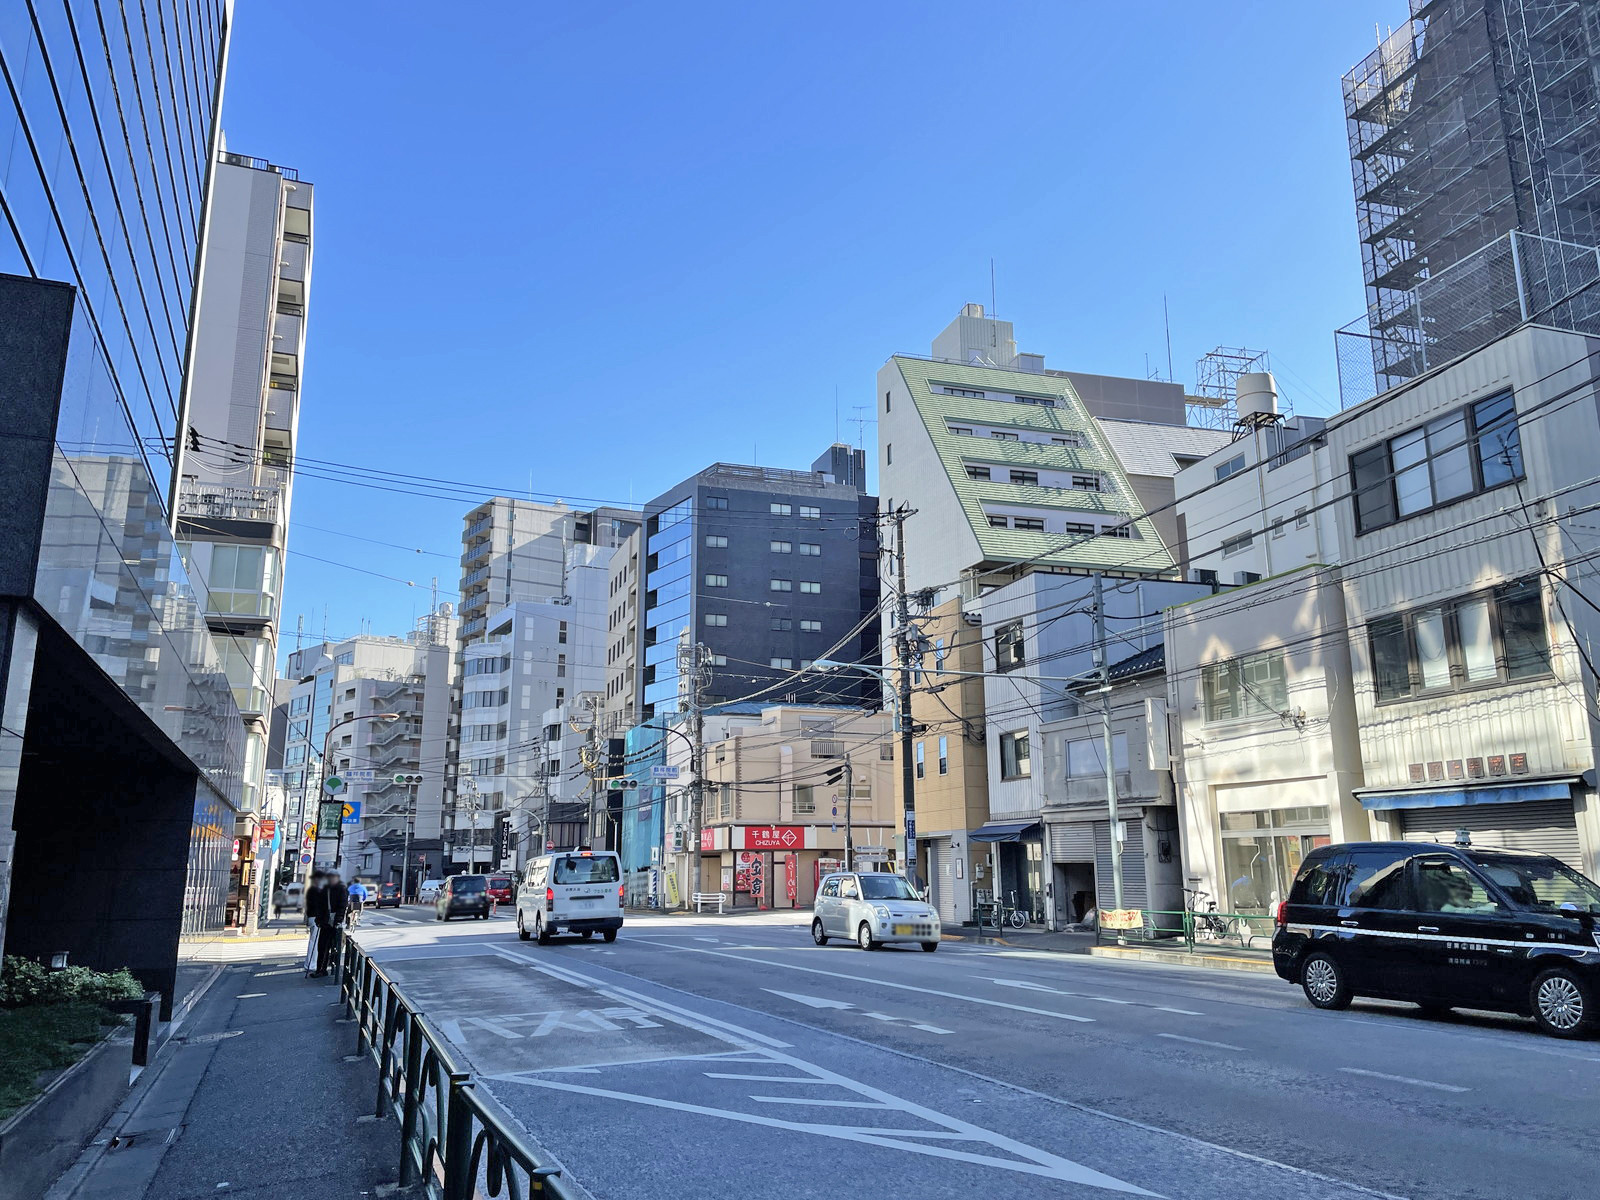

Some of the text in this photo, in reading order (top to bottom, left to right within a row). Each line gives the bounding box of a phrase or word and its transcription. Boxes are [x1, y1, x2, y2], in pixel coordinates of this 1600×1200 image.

[752, 830, 780, 839] 千鶴屋
[787, 861, 796, 896] らーめん
